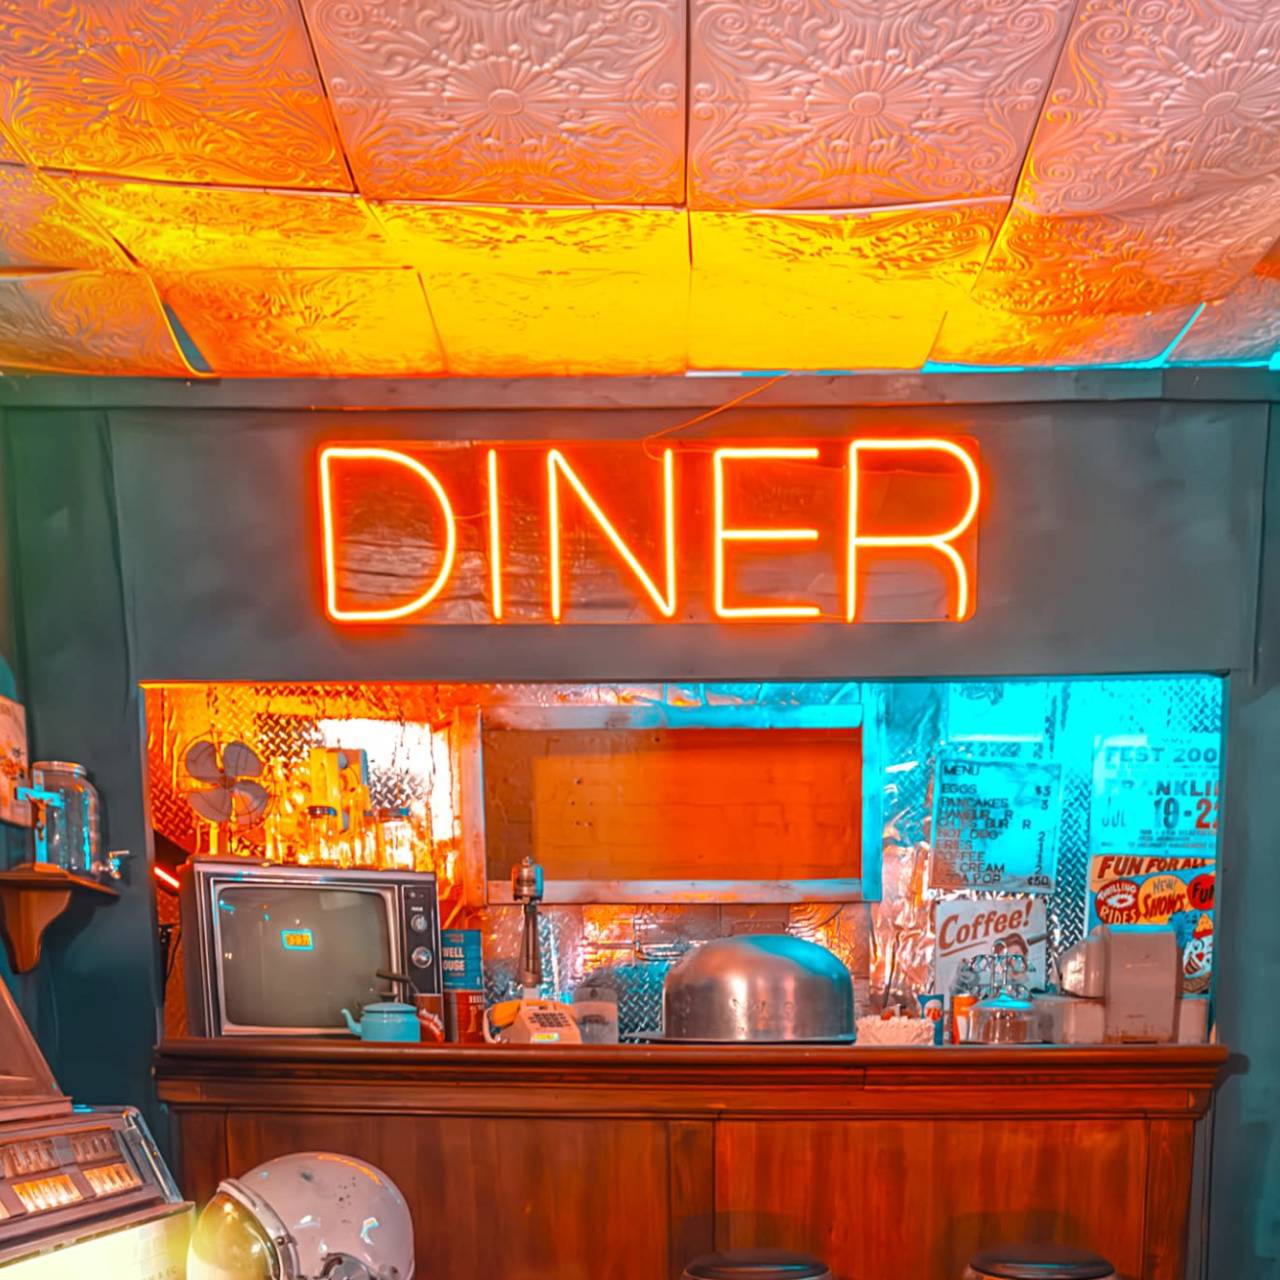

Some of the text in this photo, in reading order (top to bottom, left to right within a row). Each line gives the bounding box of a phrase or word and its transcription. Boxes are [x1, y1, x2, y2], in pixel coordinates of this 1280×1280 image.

[319, 436, 982, 624] DINER
[943, 765, 981, 776] MENU
[941, 782, 978, 795] EGGS
[940, 797, 1009, 809] PANCAKES
[959, 862, 1006, 875] CREAM
[1097, 855, 1145, 880] FUN
[1144, 857, 1181, 874] FOR
[1099, 904, 1138, 925] RIDES
[1143, 892, 1186, 920] SHOWS
[938, 899, 1034, 950] Coffee!
